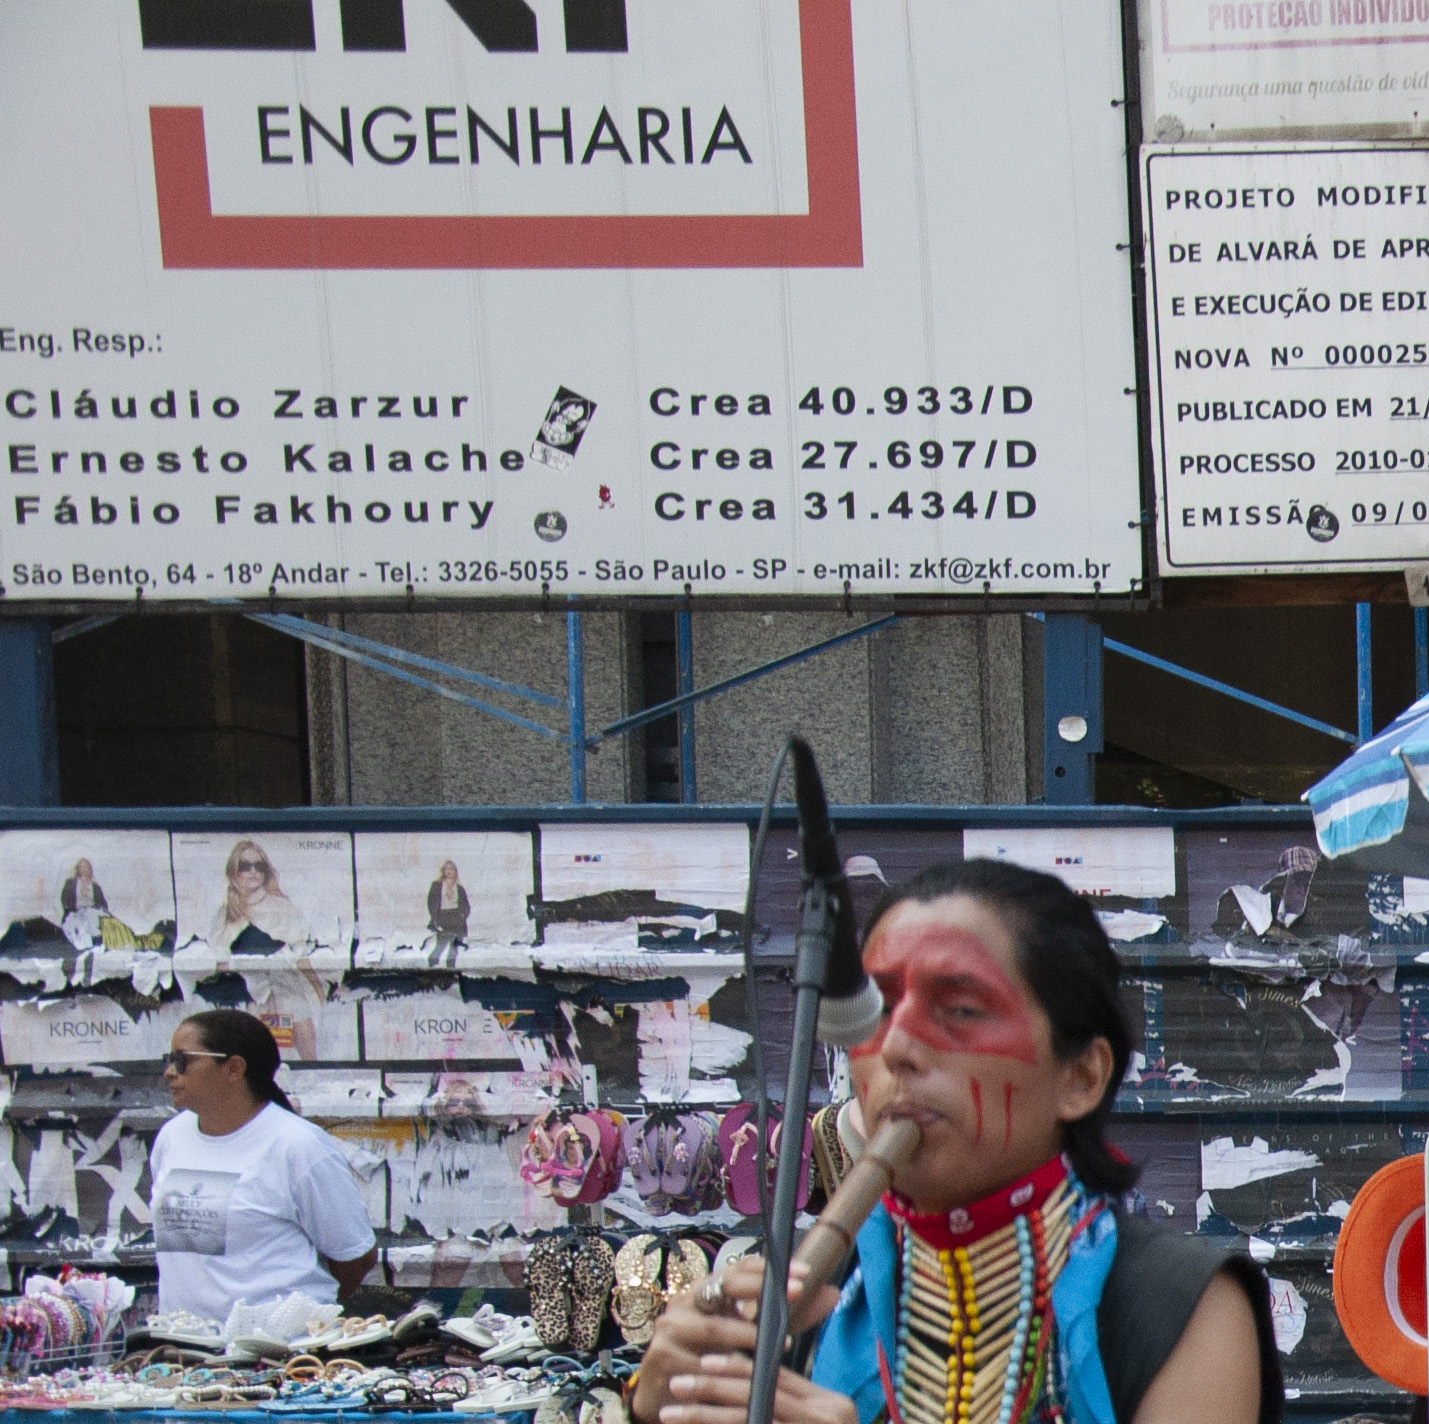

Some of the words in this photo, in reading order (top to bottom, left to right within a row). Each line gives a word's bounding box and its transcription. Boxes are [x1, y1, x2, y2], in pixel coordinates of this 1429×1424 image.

[1166, 77, 1260, 104] Segurança
[1263, 77, 1304, 97] uma
[1307, 72, 1379, 101] questão
[1384, 71, 1401, 92] de
[257, 104, 753, 166] ENGENHARIA
[1165, 187, 1295, 210] PROJETO
[1168, 243, 1202, 264] DE
[1216, 233, 1318, 262] ALVARÁ
[1333, 239, 1366, 260] DE
[1171, 296, 1186, 317] E
[1194, 287, 1331, 319] EXECUÇÃO
[1339, 292, 1373, 313] DE
[0, 327, 62, 359] Eng.
[72, 327, 162, 359] Resp.:
[1174, 347, 1251, 370] NOVA
[5, 389, 240, 419] Cláudio
[273, 389, 469, 419] Zarzur
[649, 387, 772, 417] Crea
[798, 385, 1033, 416] 40.933/D
[1177, 398, 1327, 423] PUBLICADO
[1336, 397, 1372, 418] EM
[8, 444, 248, 474] Ernesto
[283, 443, 525, 473] Kalache
[650, 441, 773, 471] Crea
[801, 439, 1037, 470] 27.697/D
[1179, 452, 1316, 475] PROCESSO
[14, 495, 180, 525] Fábio
[215, 494, 494, 530] Fakhoury
[654, 492, 776, 522] Crea
[804, 490, 1037, 521] 31.434/D
[12, 563, 63, 586] São
[71, 563, 157, 591] Bento,
[166, 563, 197, 585] 64
[223, 562, 263, 585] 18º
[270, 562, 350, 585] Andar
[374, 561, 428, 585] Tel.:
[438, 560, 569, 585] 3326-5055
[595, 559, 644, 581] São
[653, 559, 727, 581] Paulo
[752, 558, 787, 580] SP
[813, 557, 900, 582] e-mail:
[909, 557, 1111, 586] zkf@zkf.com.br
[298, 839, 343, 851] KRONNE
[48, 1018, 131, 1038] KRONNE
[413, 1016, 495, 1034] KRONE
[1354, 1132, 1390, 1142] THE
